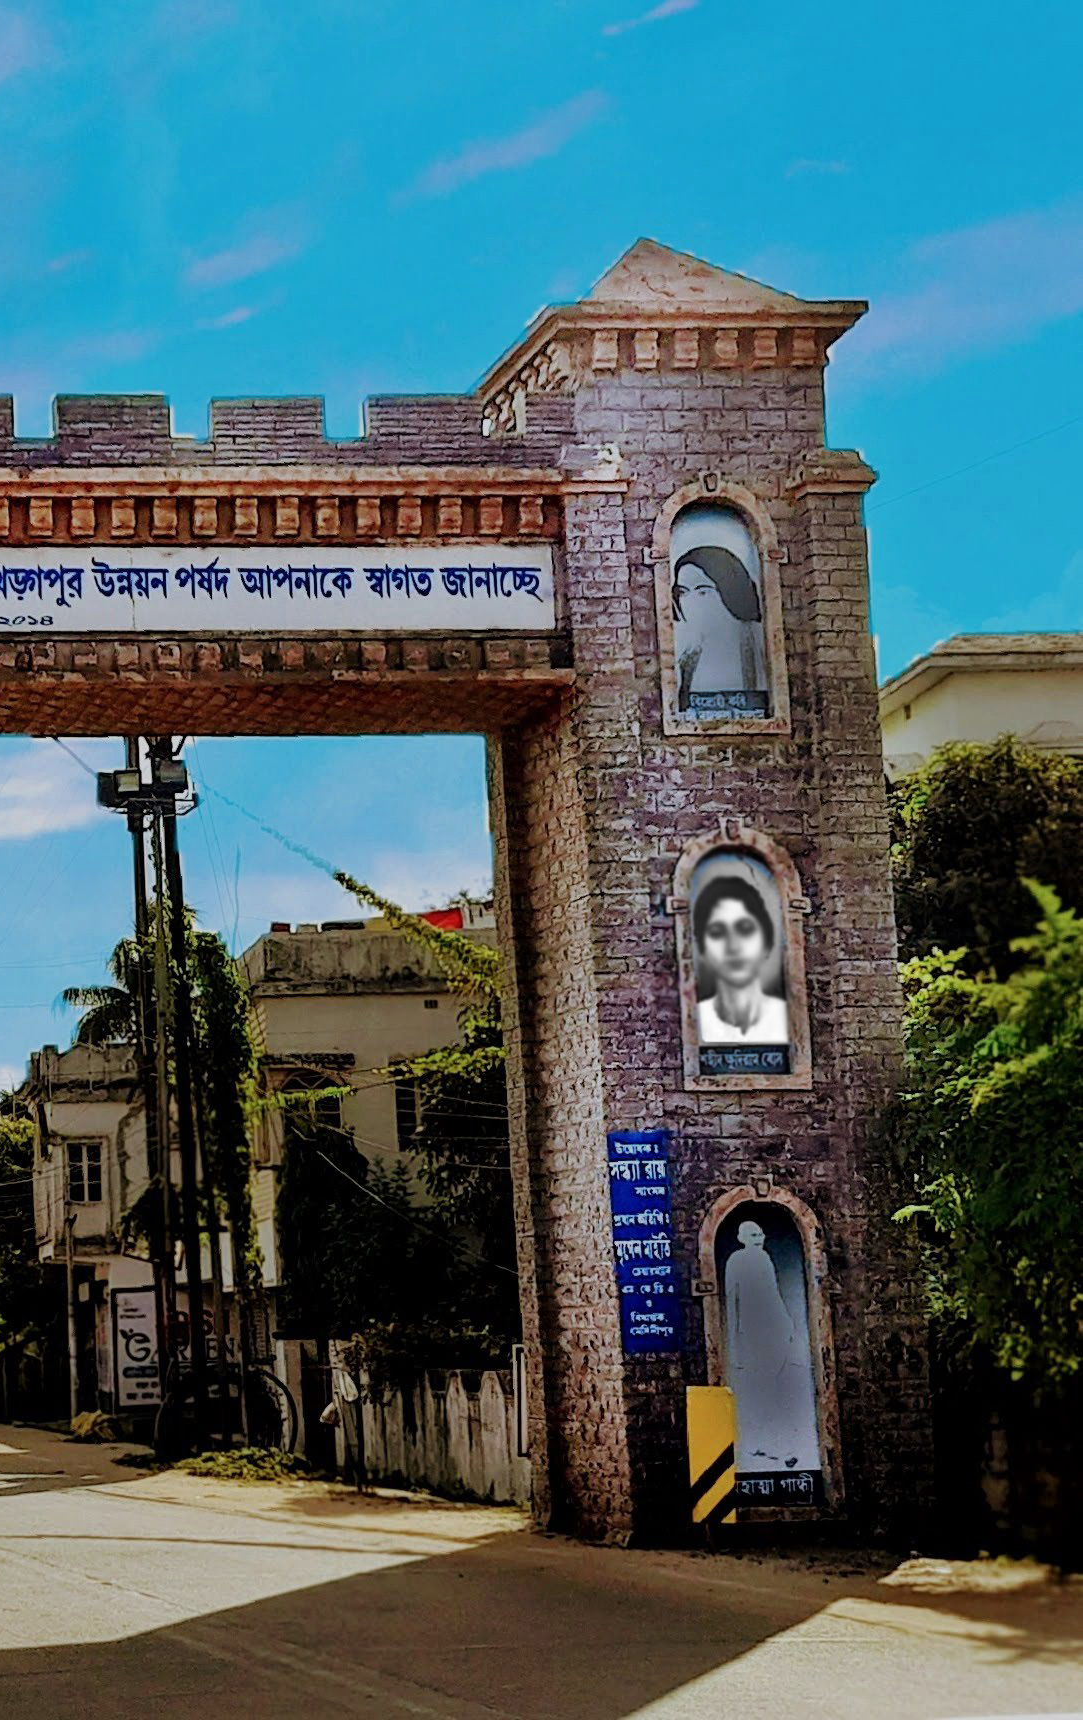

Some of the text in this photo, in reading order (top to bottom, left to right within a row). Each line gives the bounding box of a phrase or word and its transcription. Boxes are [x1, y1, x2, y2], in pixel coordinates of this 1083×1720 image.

[91, 556, 169, 600] উন্নয়ন
[175, 556, 230, 600] পর্ষদ
[238, 563, 354, 599] আপনাকে
[363, 563, 433, 600] স্বাগত
[441, 563, 543, 602] জানাচ্ছে
[609, 1158, 667, 1181] সন্ধ্যা রায়
[642, 1231, 671, 1260] মাইতি
[780, 1472, 814, 1492] গান্ধী
